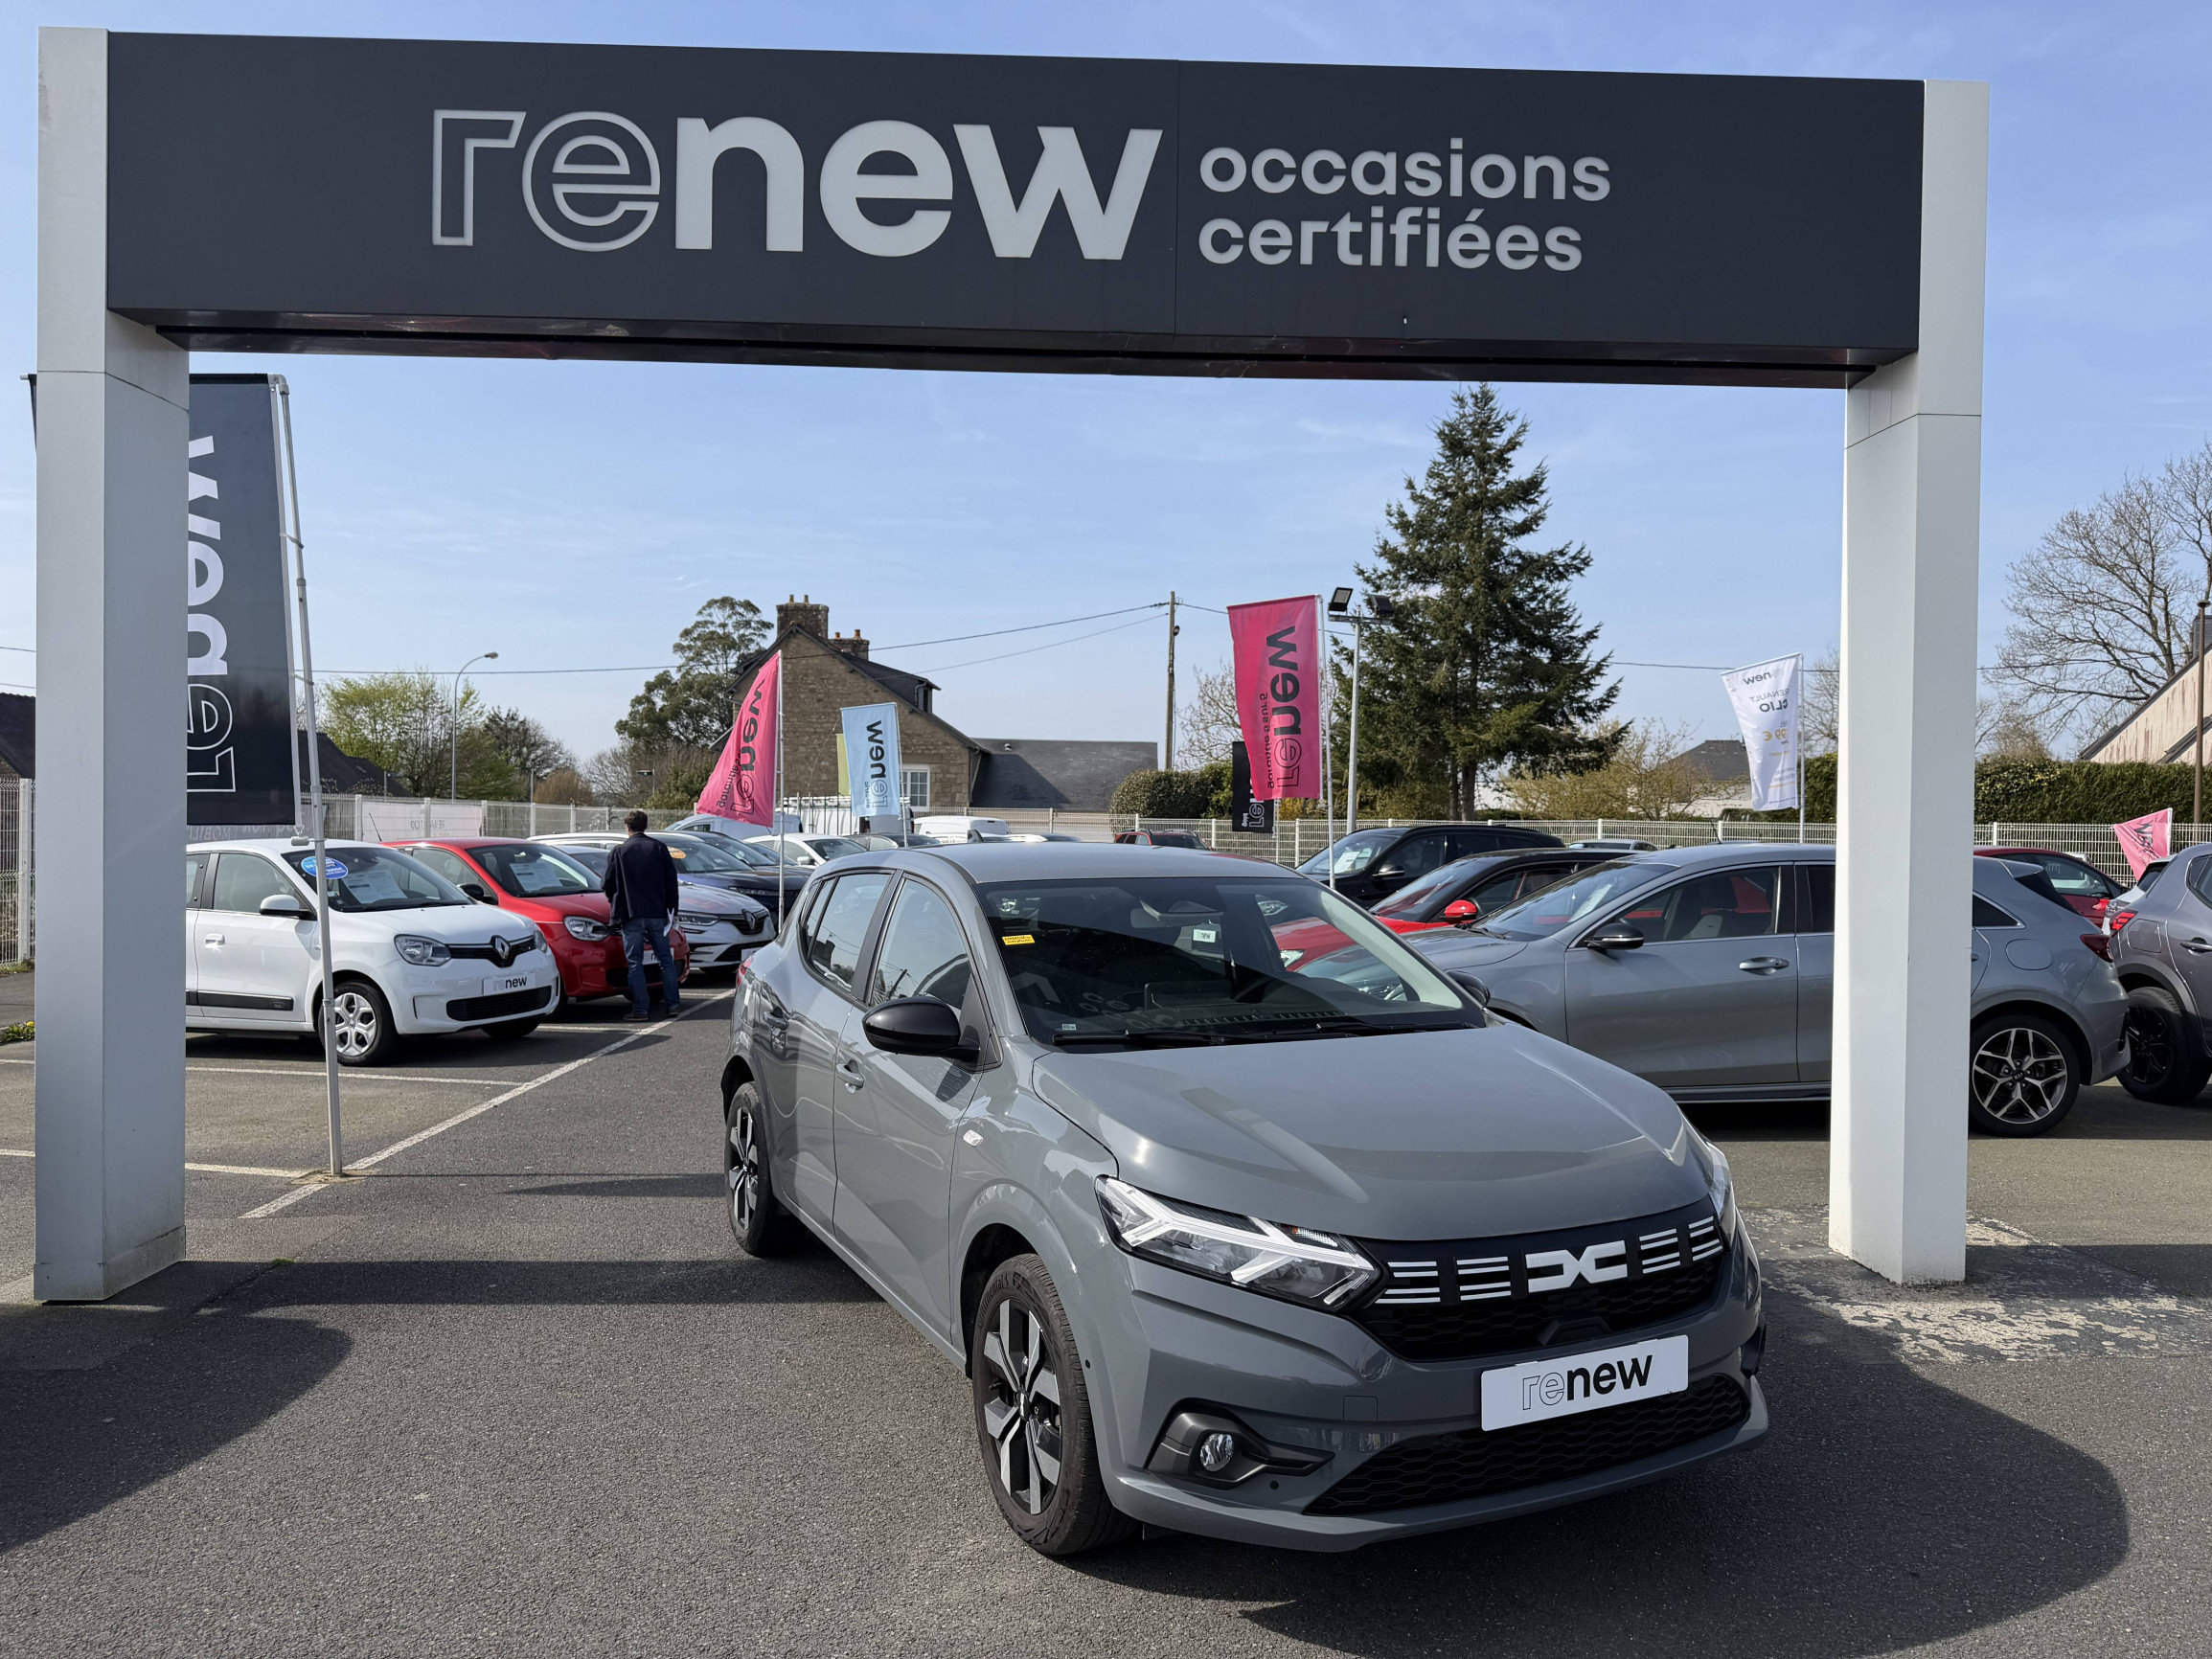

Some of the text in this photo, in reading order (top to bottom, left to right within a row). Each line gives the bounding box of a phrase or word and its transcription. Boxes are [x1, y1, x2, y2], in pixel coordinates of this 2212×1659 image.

[431, 109, 1164, 261] renew
[1199, 137, 1610, 201] occasions
[1198, 205, 1583, 271] certifiées
[492, 976, 528, 991] renew
[1521, 1354, 1653, 1411] renew
